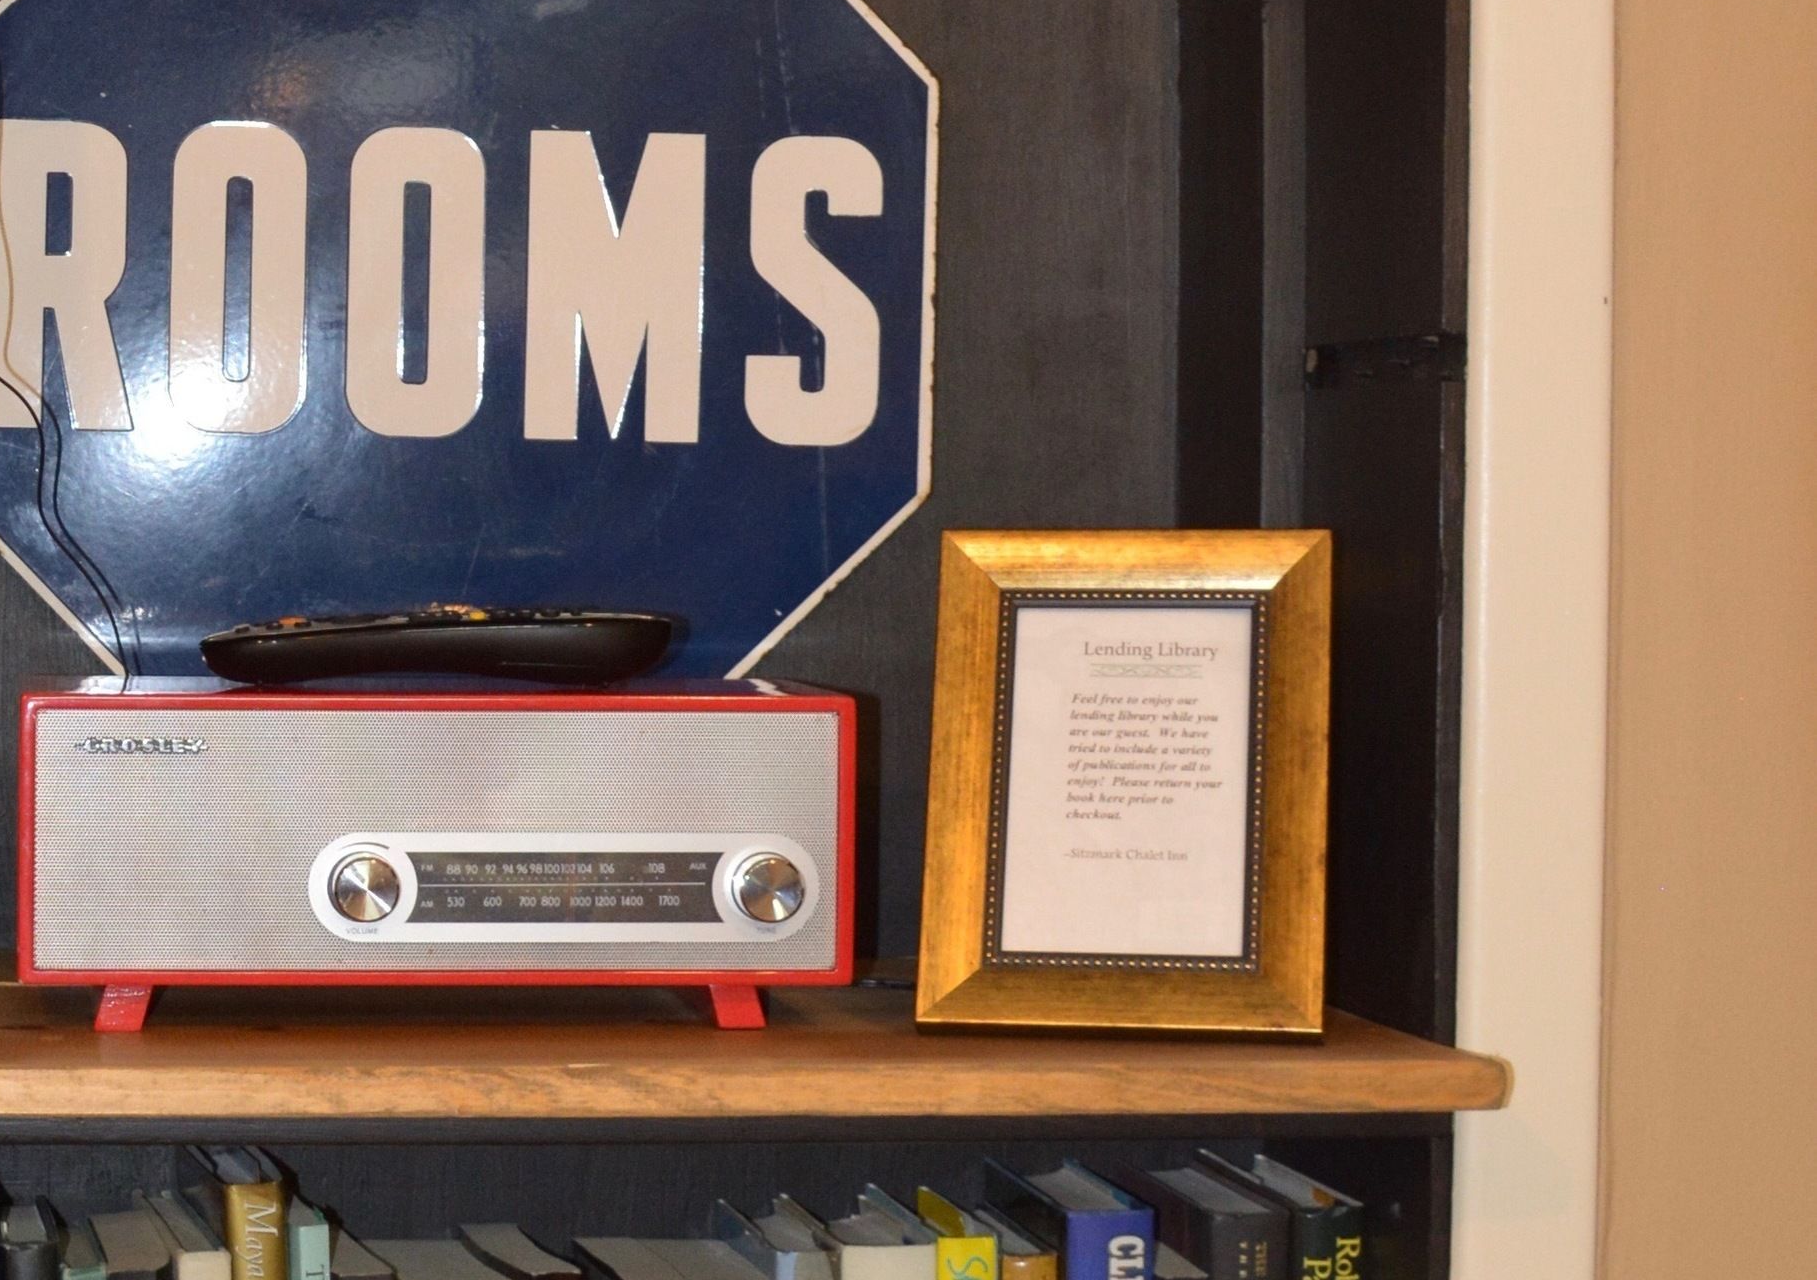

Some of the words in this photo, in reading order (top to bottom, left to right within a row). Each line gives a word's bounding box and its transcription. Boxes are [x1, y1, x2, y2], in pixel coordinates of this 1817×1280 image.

[1084, 642, 1152, 659] Lending
[1158, 643, 1218, 660] Library
[1071, 694, 1097, 705] Feel
[447, 895, 465, 907] 530
[483, 895, 502, 908] 600
[518, 895, 536, 908] 700
[541, 895, 561, 908] 800
[594, 895, 617, 908] 1200
[620, 895, 643, 908] 1400
[659, 895, 680, 908] 1700
